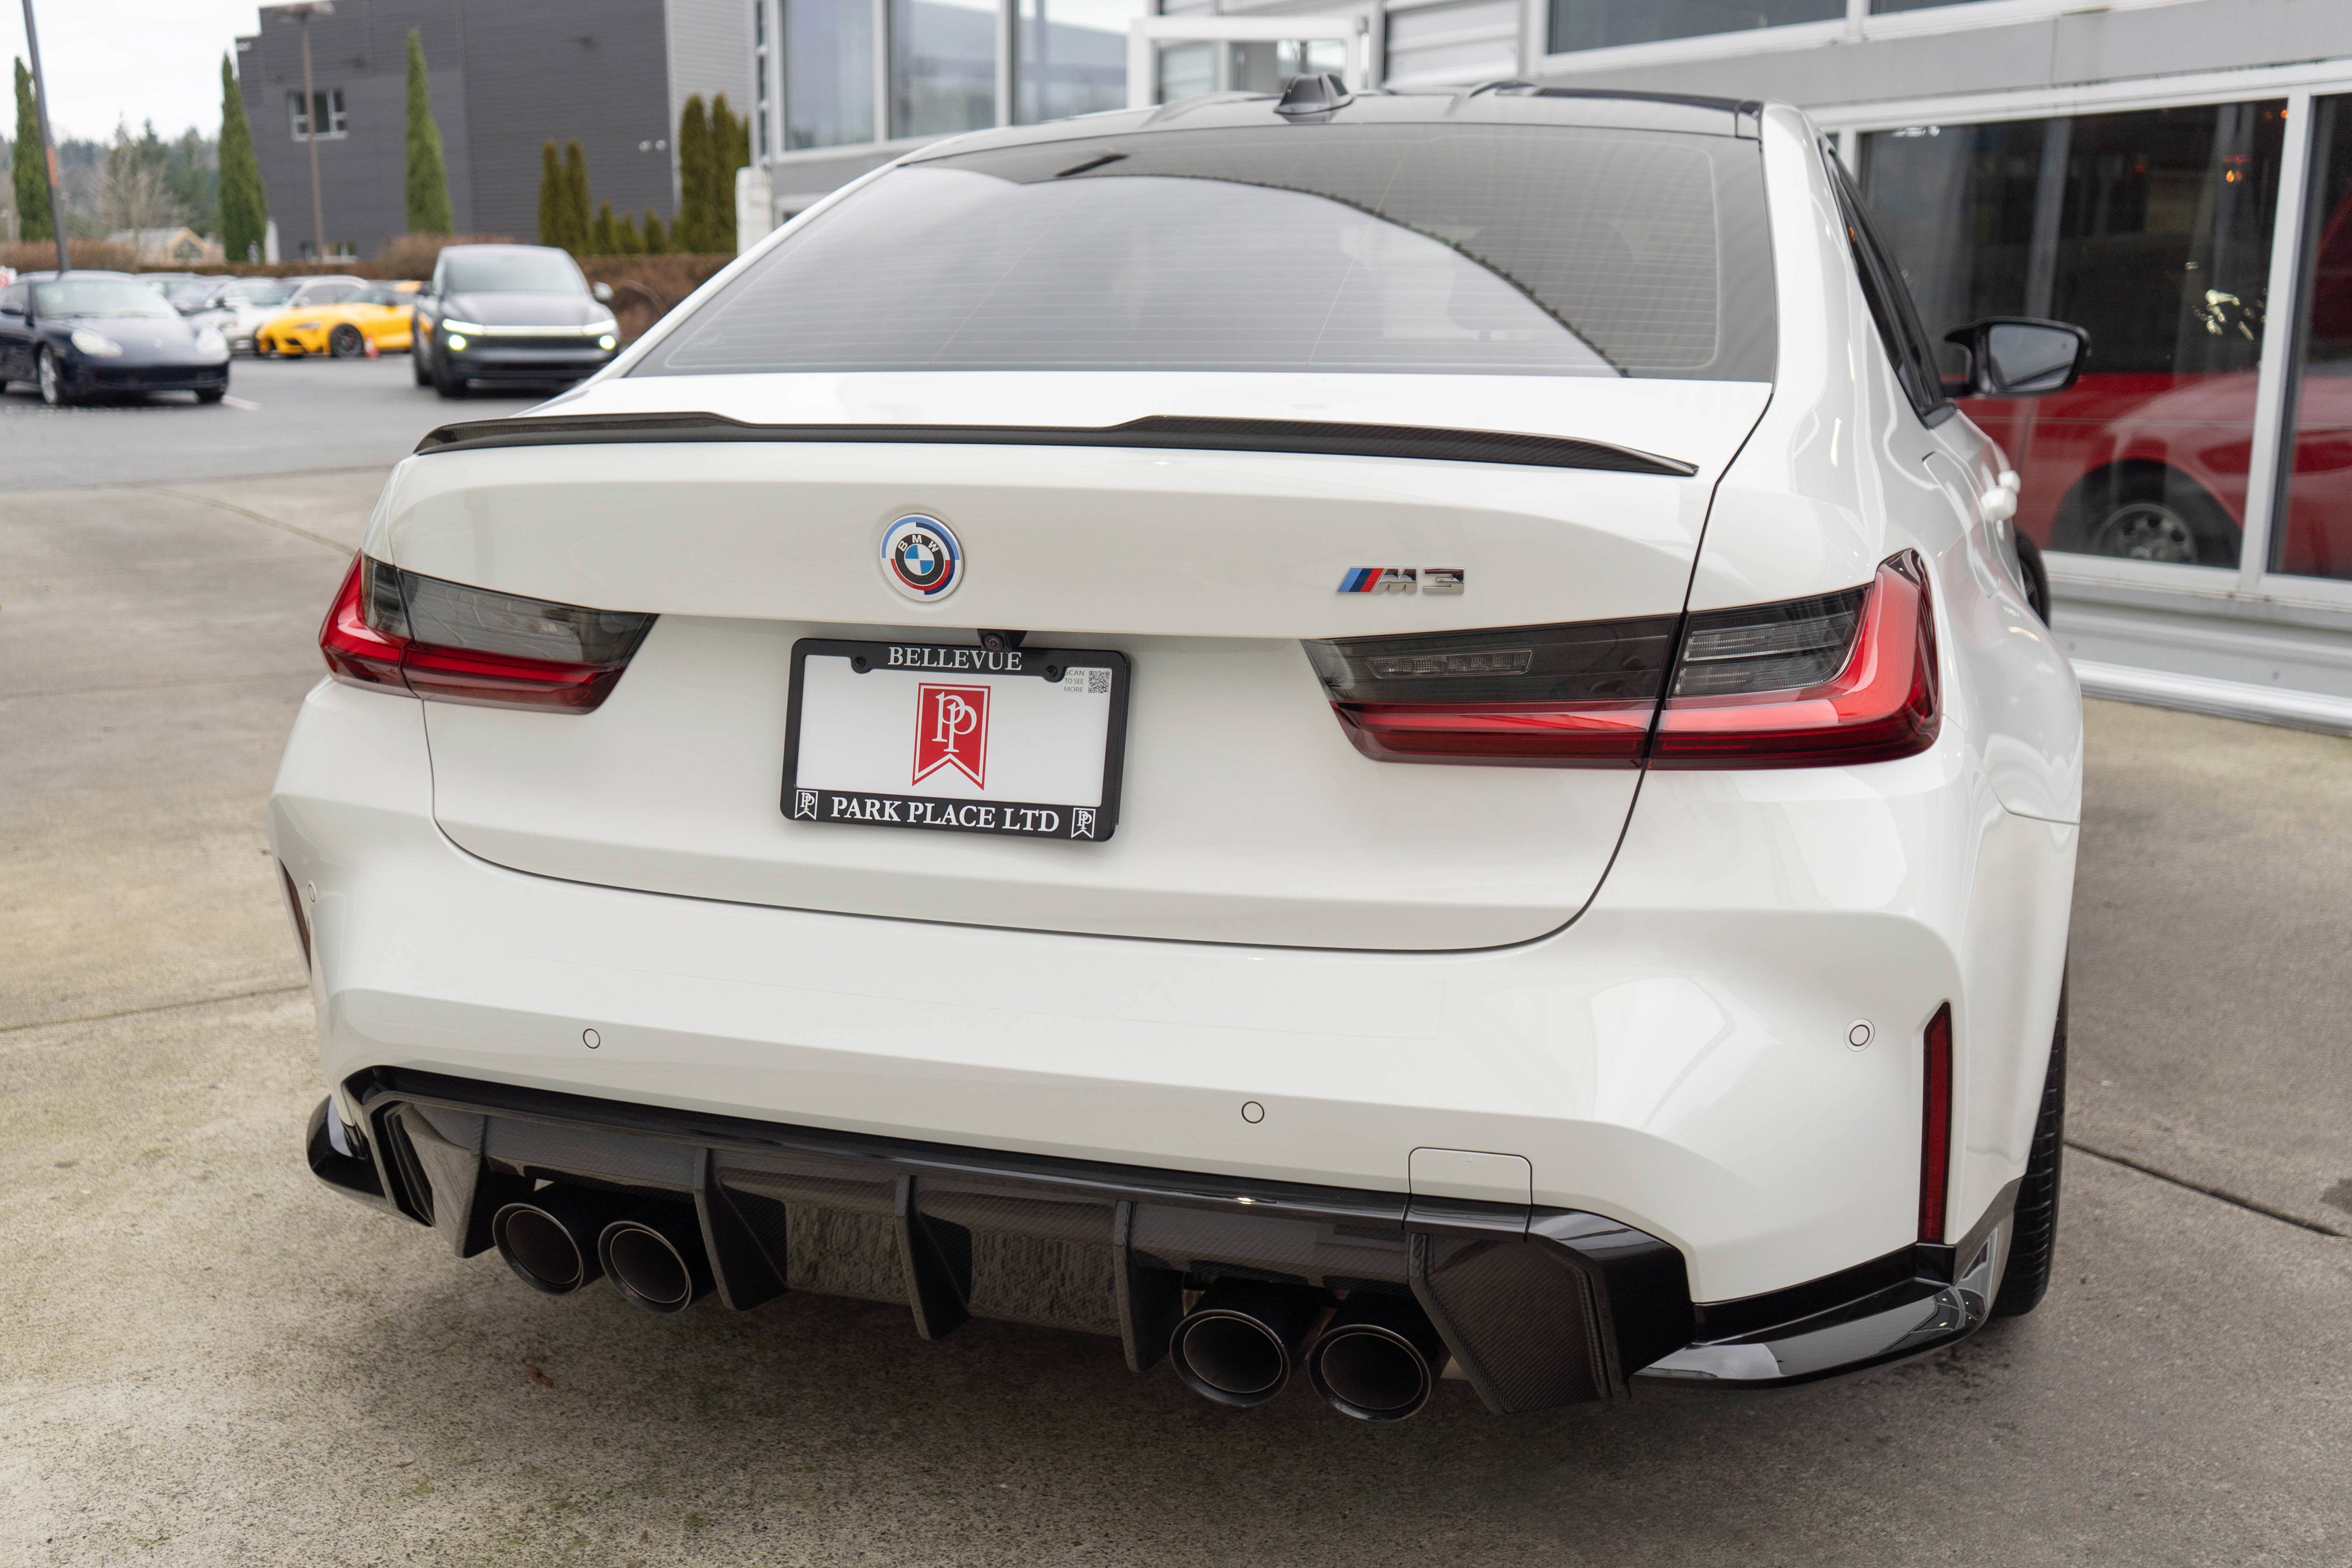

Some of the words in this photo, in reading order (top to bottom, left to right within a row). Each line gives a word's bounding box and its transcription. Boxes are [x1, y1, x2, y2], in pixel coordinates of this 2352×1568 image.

[898, 535, 939, 552] BMW
[1371, 567, 1464, 594] M3
[888, 647, 1022, 670] BELLEVUE
[830, 797, 902, 822] PARK
[907, 802, 995, 828] PLACE
[1002, 808, 1059, 832] LTD
